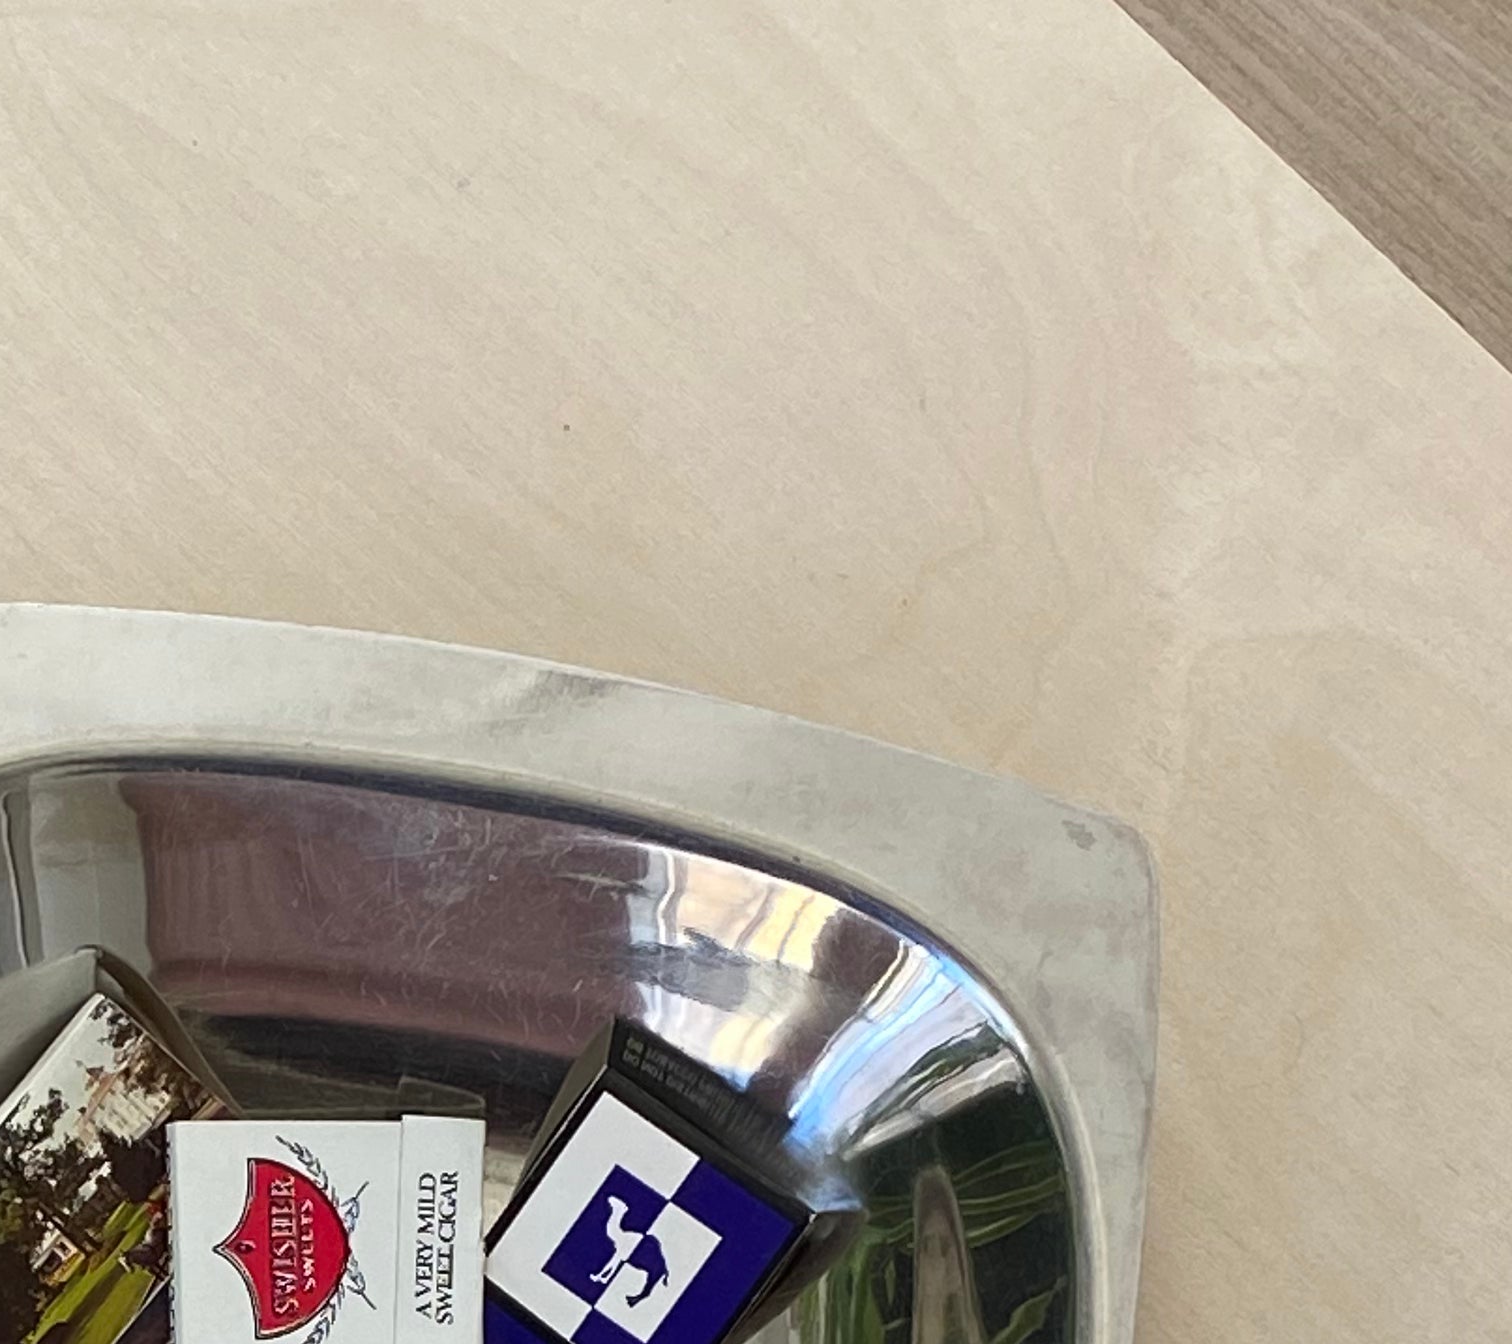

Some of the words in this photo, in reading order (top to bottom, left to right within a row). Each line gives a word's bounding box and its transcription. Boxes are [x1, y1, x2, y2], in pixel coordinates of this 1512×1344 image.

[415, 1172, 437, 1233] MILD
[437, 1170, 459, 1244] CIGAR
[270, 1174, 300, 1316] SWISHER
[300, 1198, 317, 1294] SWEETS
[414, 1239, 435, 1300] VERY
[415, 1303, 434, 1319] A
[435, 1243, 455, 1326] SWEET
